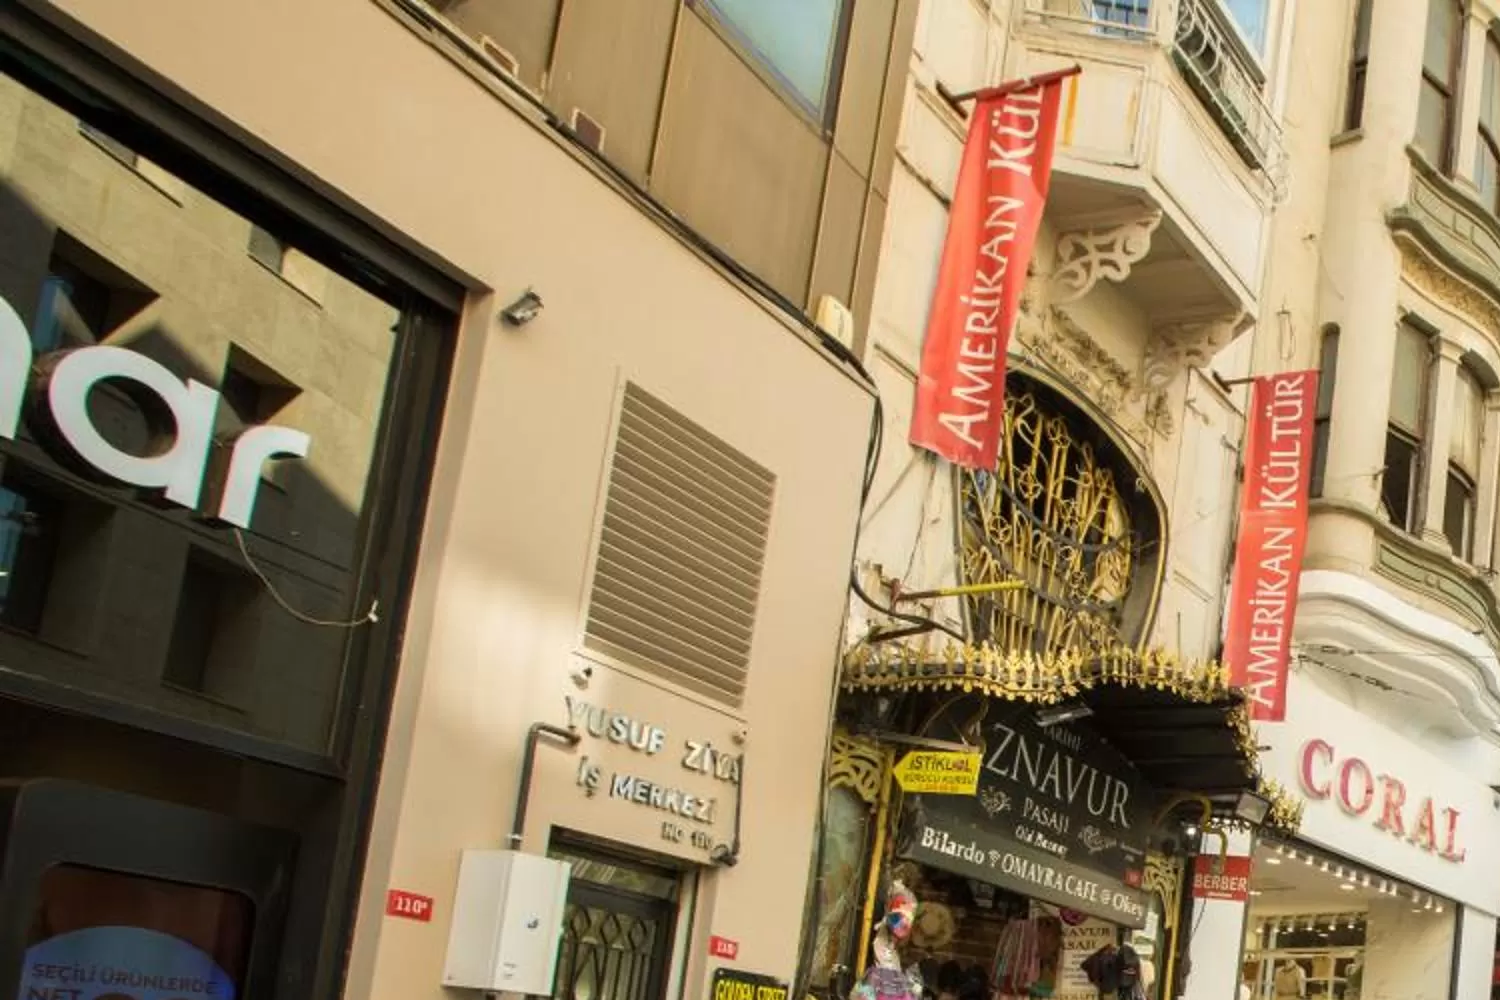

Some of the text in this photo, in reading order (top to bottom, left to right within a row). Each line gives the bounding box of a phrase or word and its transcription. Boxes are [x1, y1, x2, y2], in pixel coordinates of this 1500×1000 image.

[936, 193, 1025, 452] AMERİKAN
[1246, 372, 1306, 709] AMERİKAN KÜLTÜR
[565, 695, 666, 756] YUSUF
[1301, 737, 1467, 866] CORAL
[920, 826, 986, 866] Bilardo
[1064, 874, 1099, 904] CAFE
[1193, 873, 1247, 893] BERBER
[32, 961, 98, 985] SEÇİLİ
